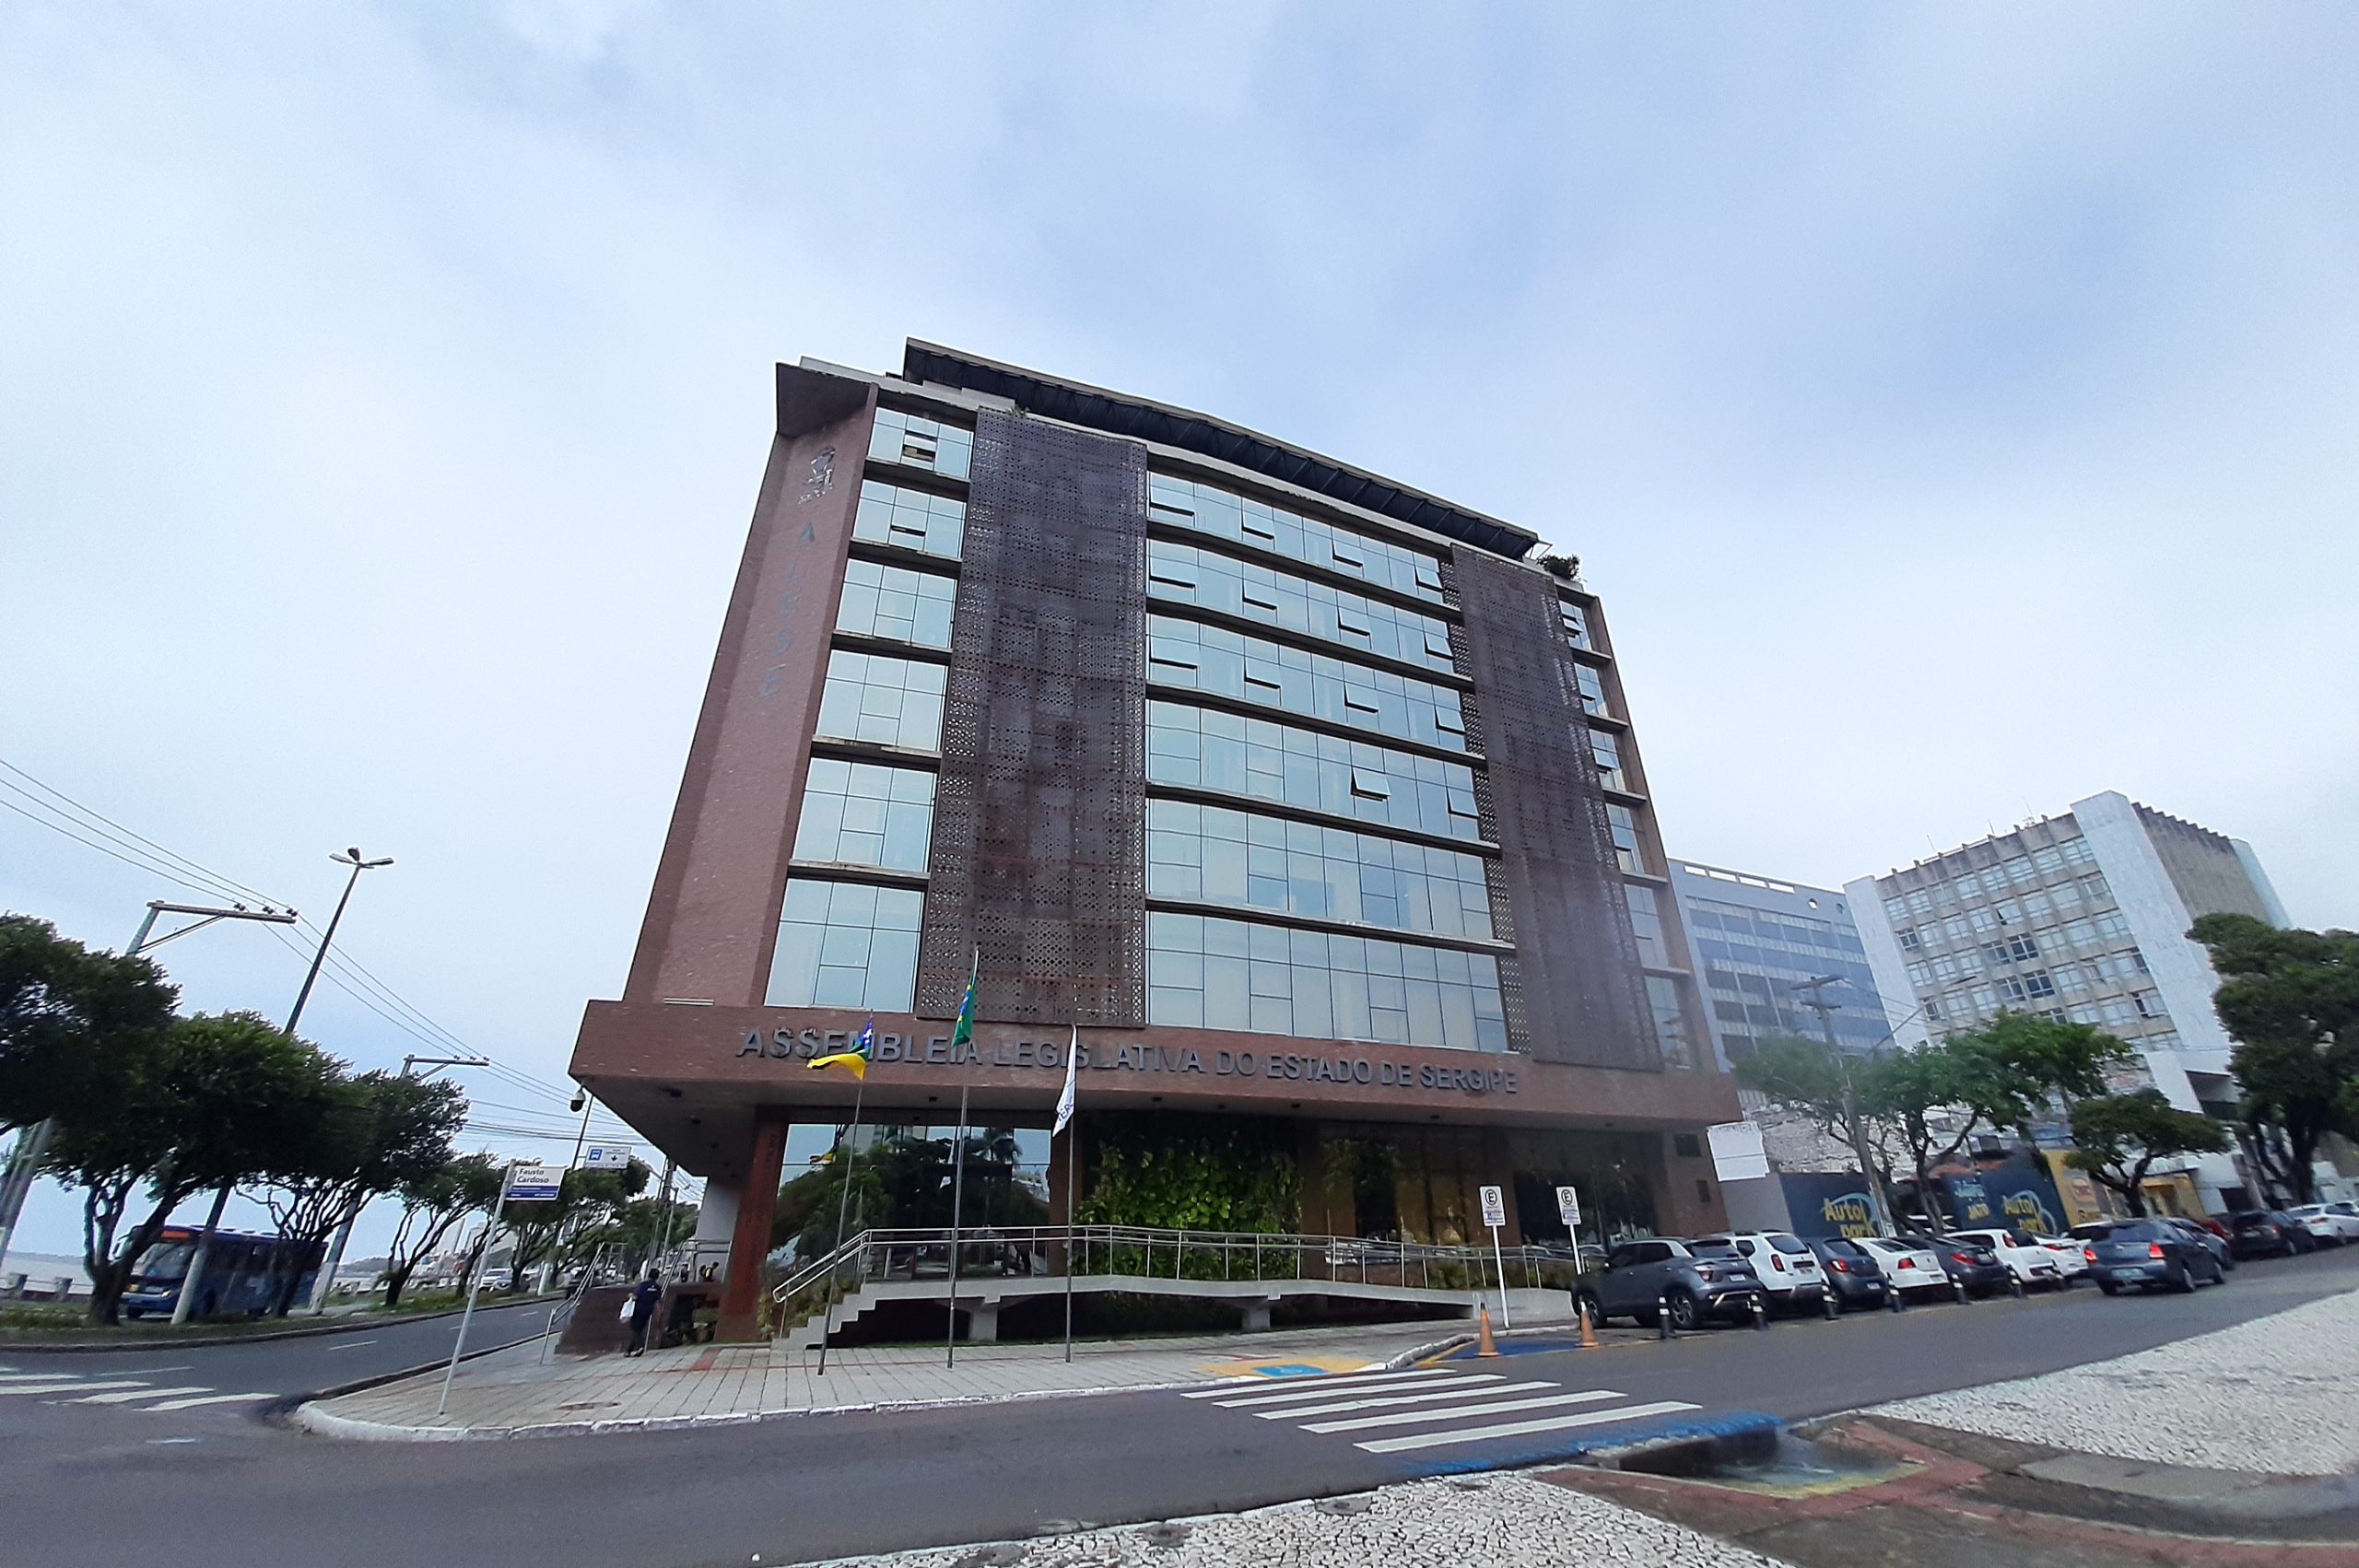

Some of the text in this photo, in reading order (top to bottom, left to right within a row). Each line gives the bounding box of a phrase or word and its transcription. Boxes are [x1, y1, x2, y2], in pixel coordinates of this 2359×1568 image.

[993, 1038, 1208, 1075] LEGISLATIVA
[1215, 1050, 1259, 1077] DO
[1267, 1053, 1374, 1084] ESTADO
[1380, 1060, 1414, 1087] DE
[1420, 1062, 1519, 1094] SERGIPE
[519, 1167, 546, 1176] Fausto
[516, 1176, 550, 1184] Cardoso
